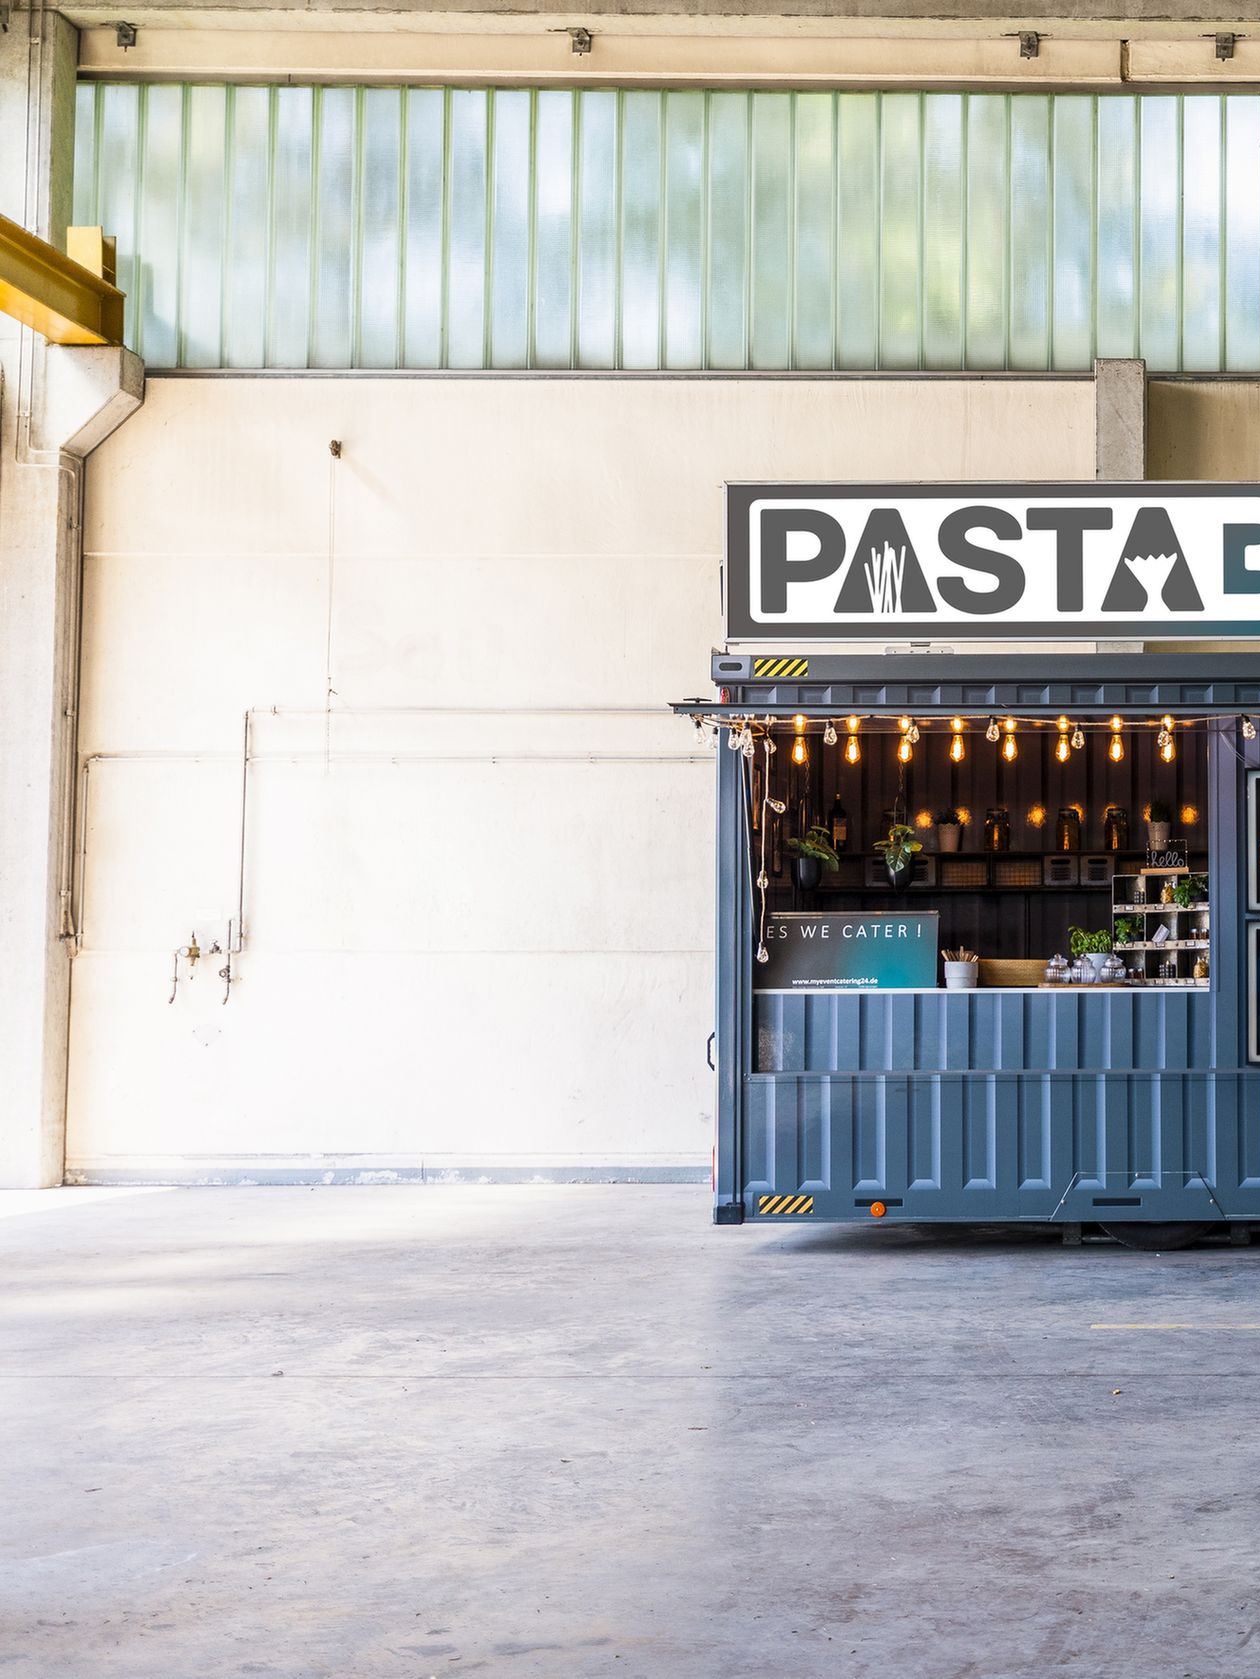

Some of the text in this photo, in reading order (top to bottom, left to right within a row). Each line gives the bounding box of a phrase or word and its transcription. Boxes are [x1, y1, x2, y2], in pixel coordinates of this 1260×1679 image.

[1151, 850, 1185, 868] hello
[766, 925, 788, 939] ES
[800, 925, 830, 939] WE
[791, 977, 879, 986] www.myeventcatering24.de
